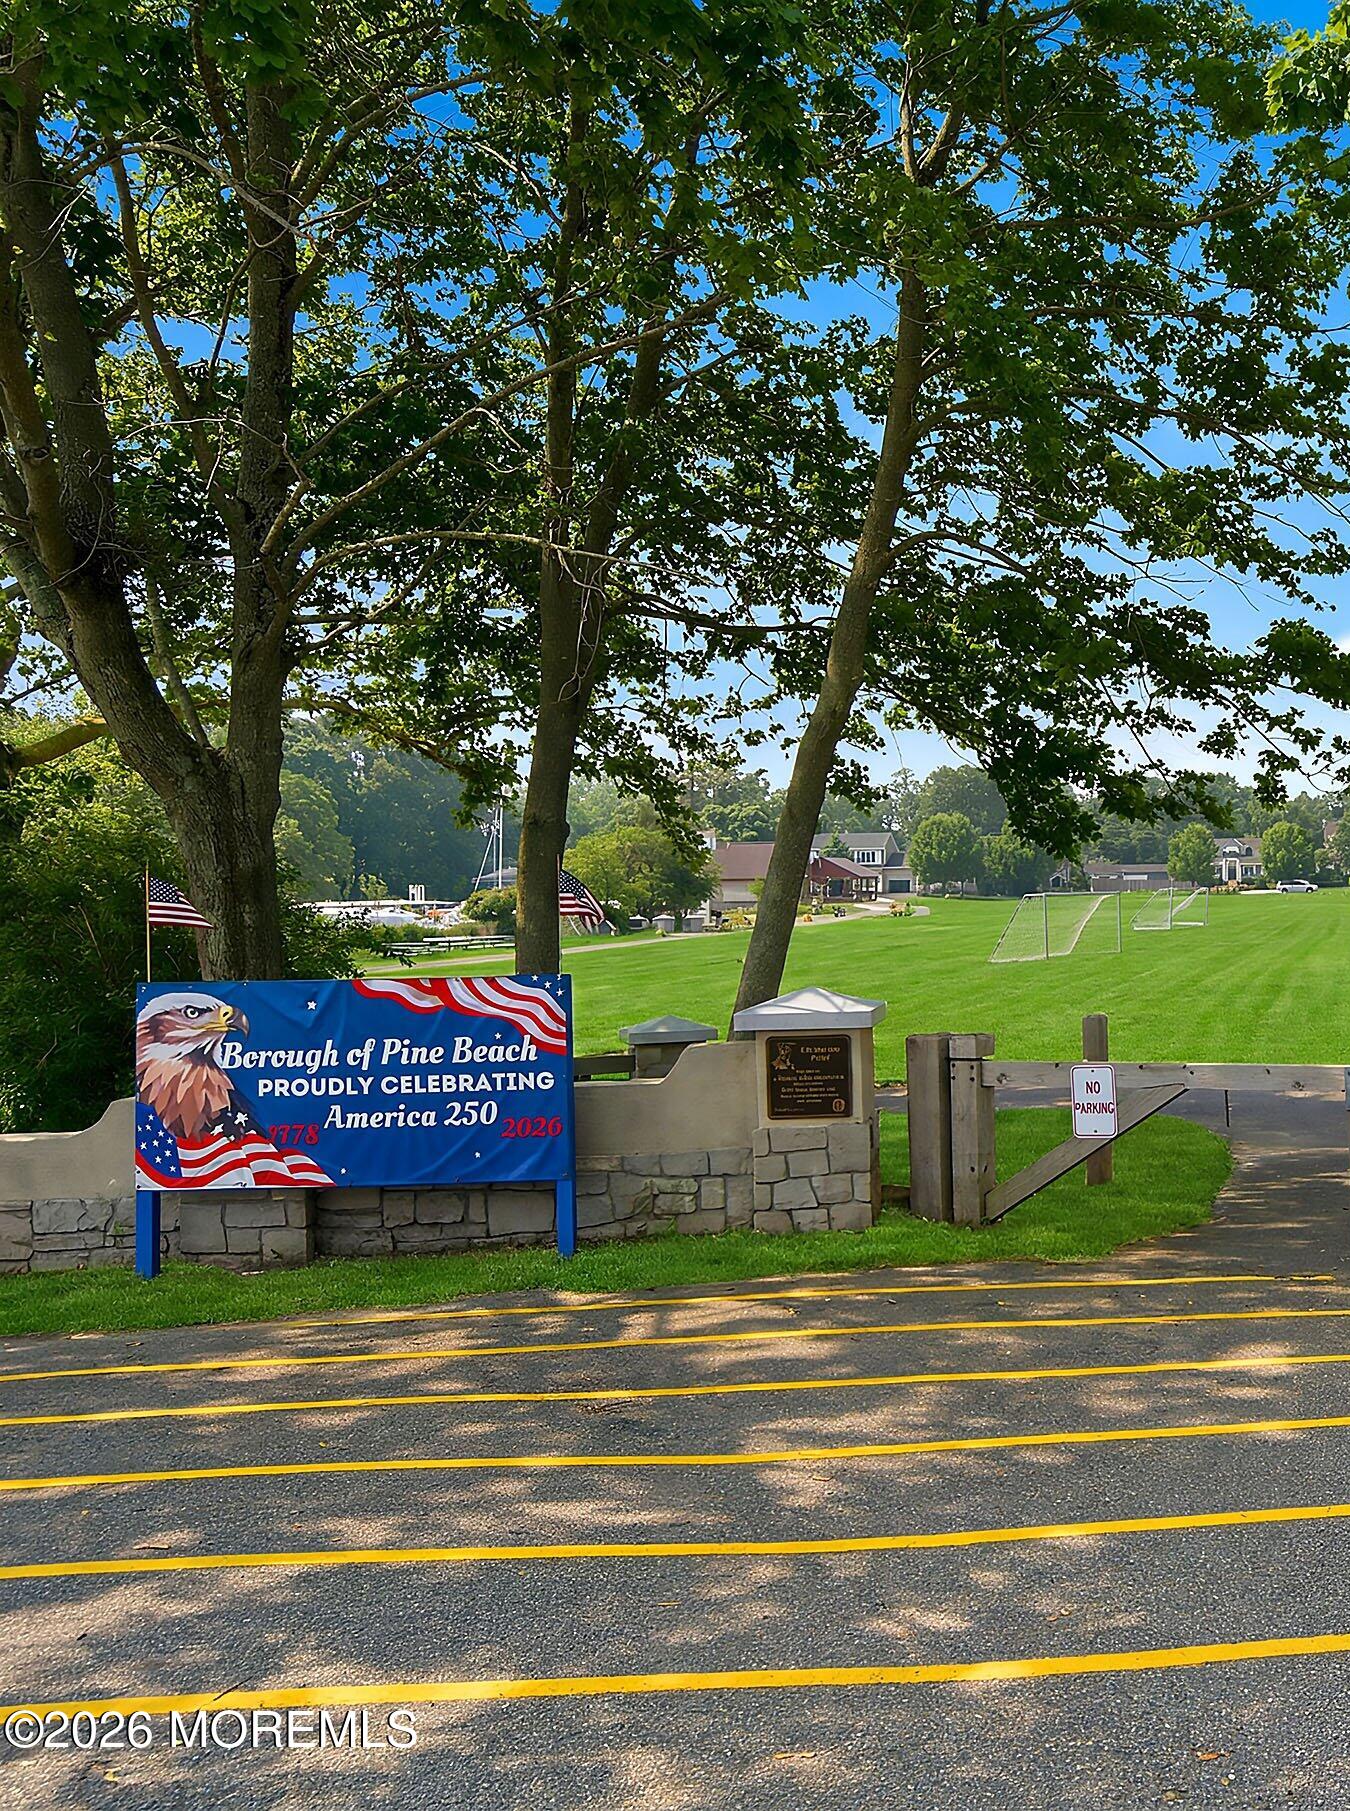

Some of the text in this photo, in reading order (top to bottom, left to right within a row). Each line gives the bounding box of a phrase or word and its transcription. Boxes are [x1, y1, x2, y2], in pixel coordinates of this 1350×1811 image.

[222, 1034, 538, 1075] Borough of Pine Beach
[258, 1071, 555, 1097] PROUDLY CELEBRATING
[1085, 1081, 1101, 1094] NO
[323, 1100, 499, 1129] America 250
[1075, 1102, 1115, 1114] PARKING
[500, 1116, 563, 1138] 2026
